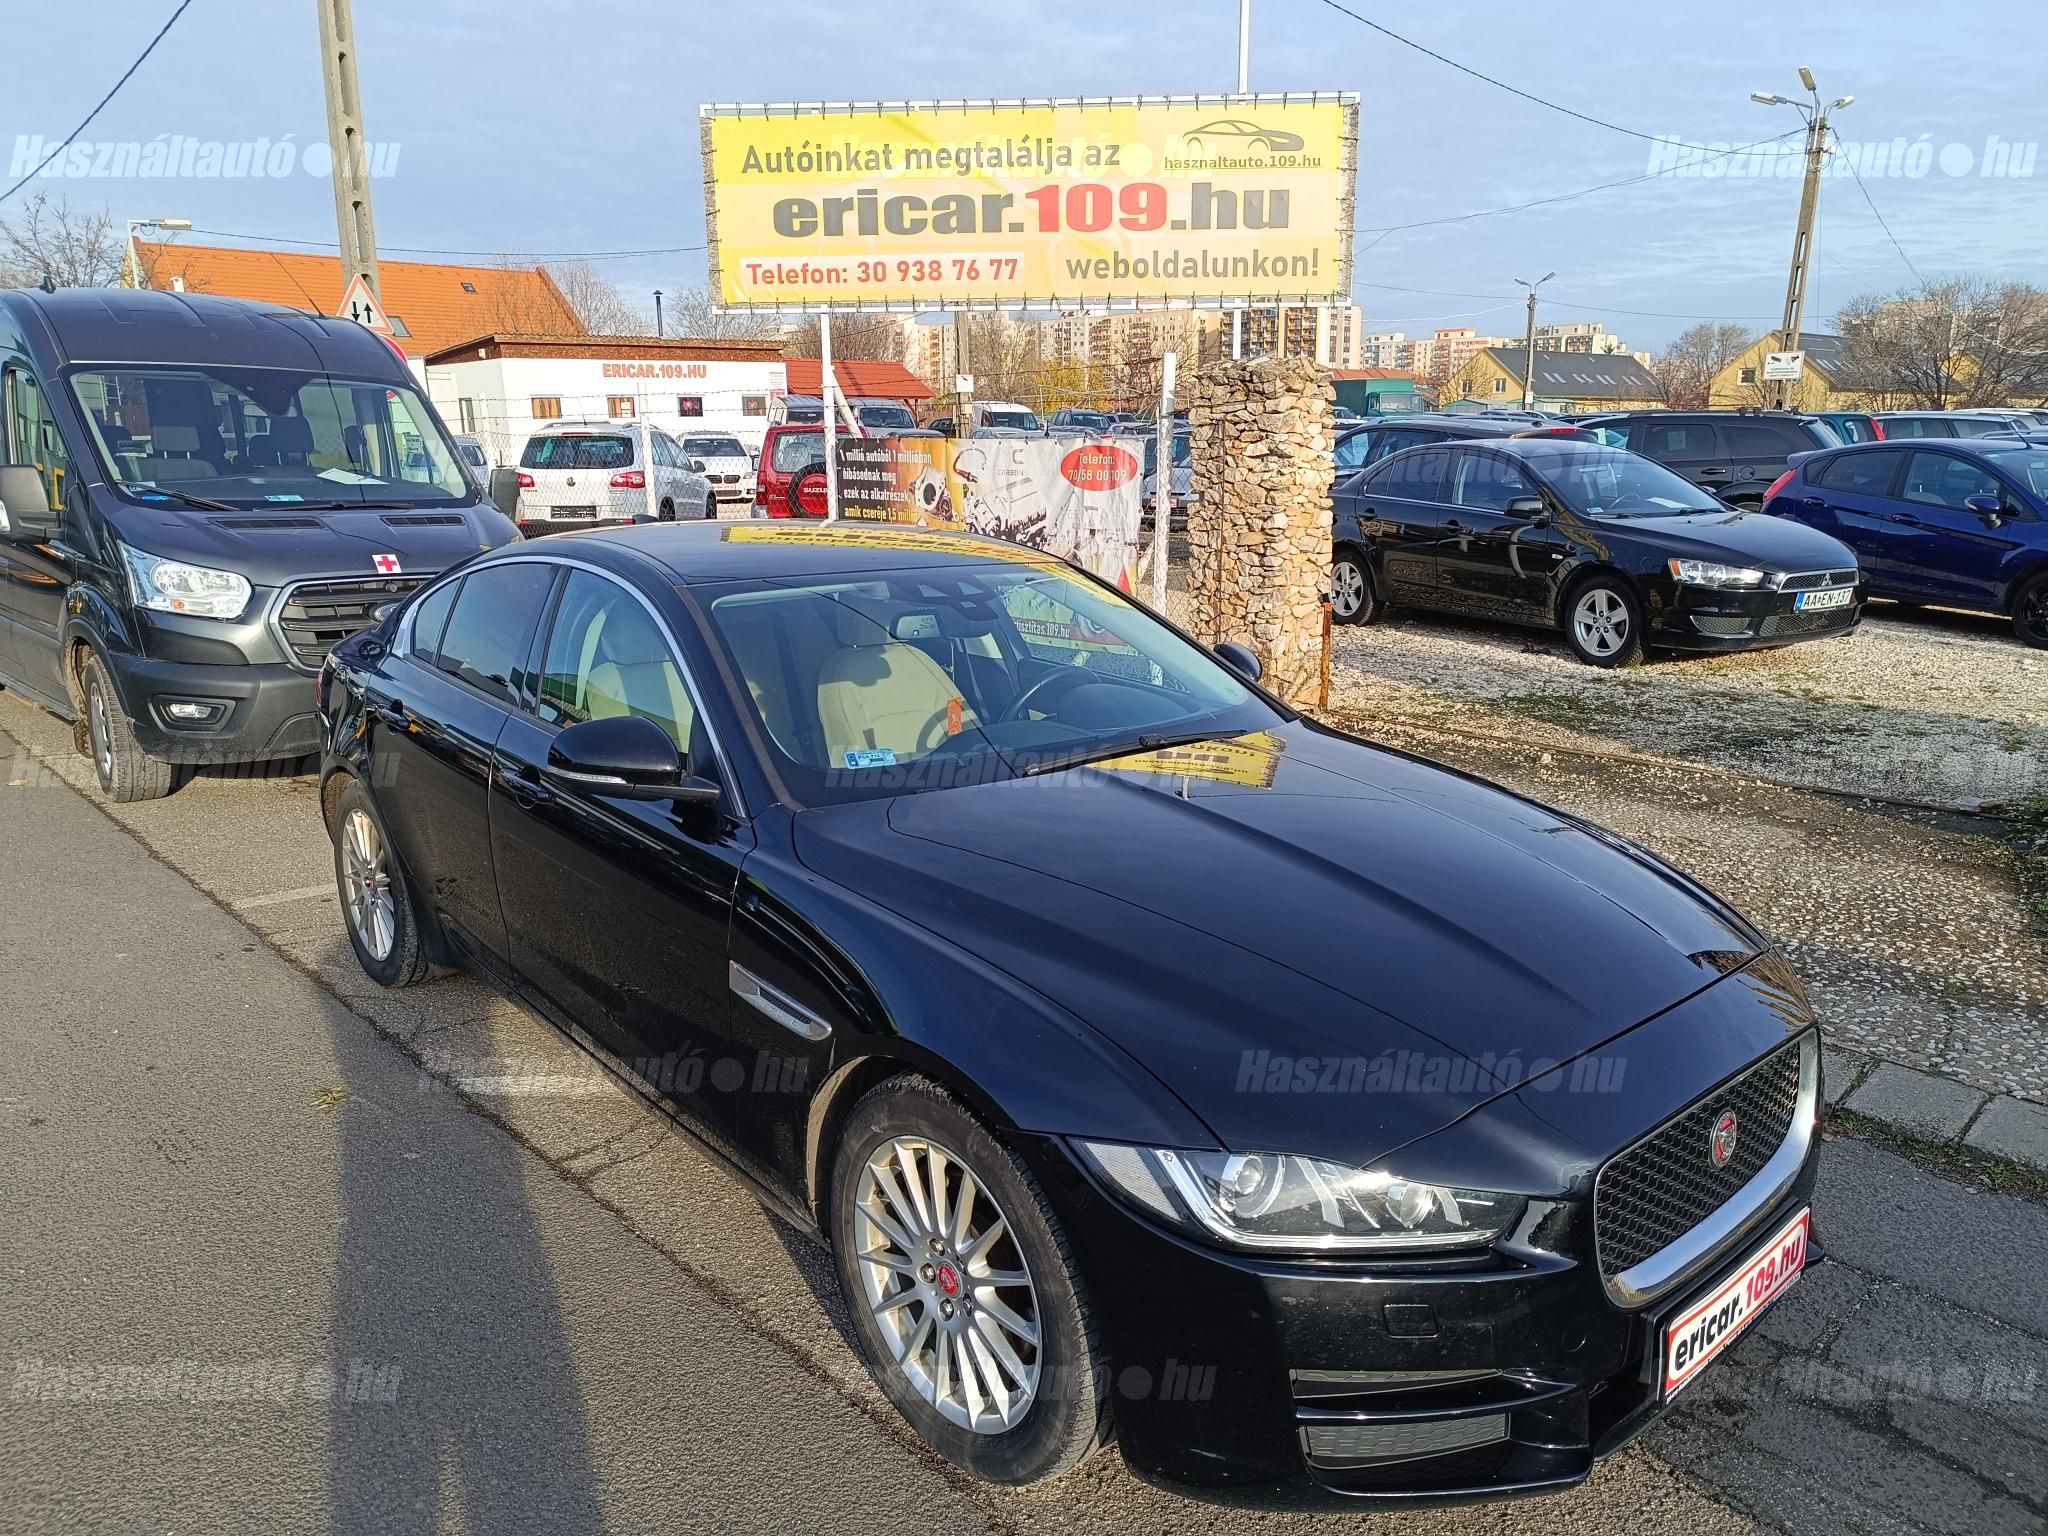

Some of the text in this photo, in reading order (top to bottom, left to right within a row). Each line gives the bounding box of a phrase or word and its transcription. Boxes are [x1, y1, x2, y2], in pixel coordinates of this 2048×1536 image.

[741, 134, 1121, 177] Autóinkat megtalálja az
[1163, 153, 1322, 169] hasznaltauto.109.hu
[773, 182, 1290, 237] ericar.109.hu
[746, 257, 1019, 284] Telefon: 30 938 76 77
[1066, 247, 1319, 281] weboldalunkon!
[602, 363, 707, 379] ERICAR.109.HU
[1079, 453, 1115, 465] Telefon:
[843, 486, 860, 499] ezek
